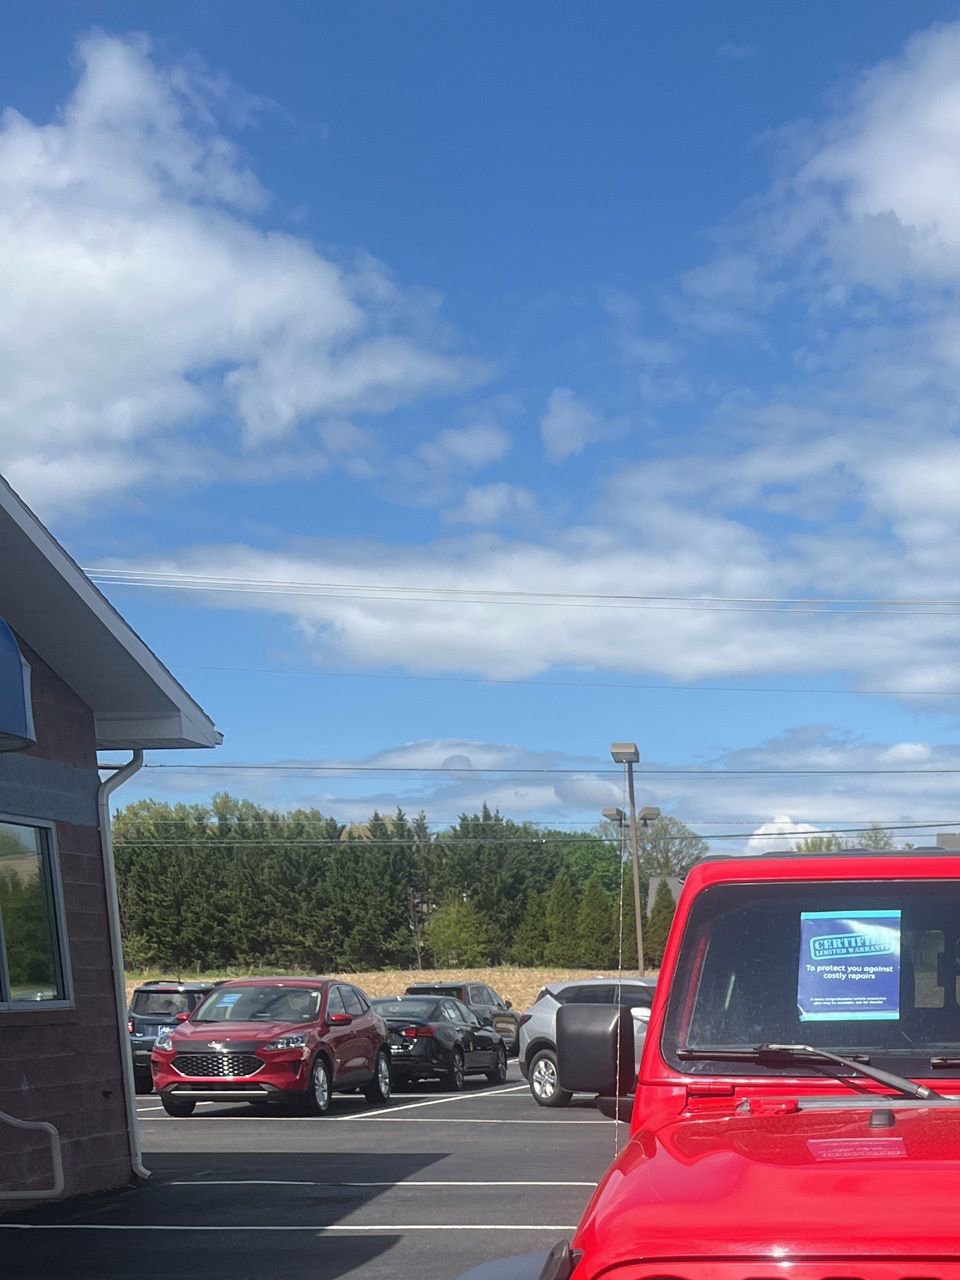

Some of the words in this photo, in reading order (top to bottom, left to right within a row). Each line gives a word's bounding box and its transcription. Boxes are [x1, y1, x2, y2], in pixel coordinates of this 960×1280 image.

[815, 947, 846, 956] LIMITED
[817, 965, 846, 973] protect
[823, 972, 847, 980] costly
